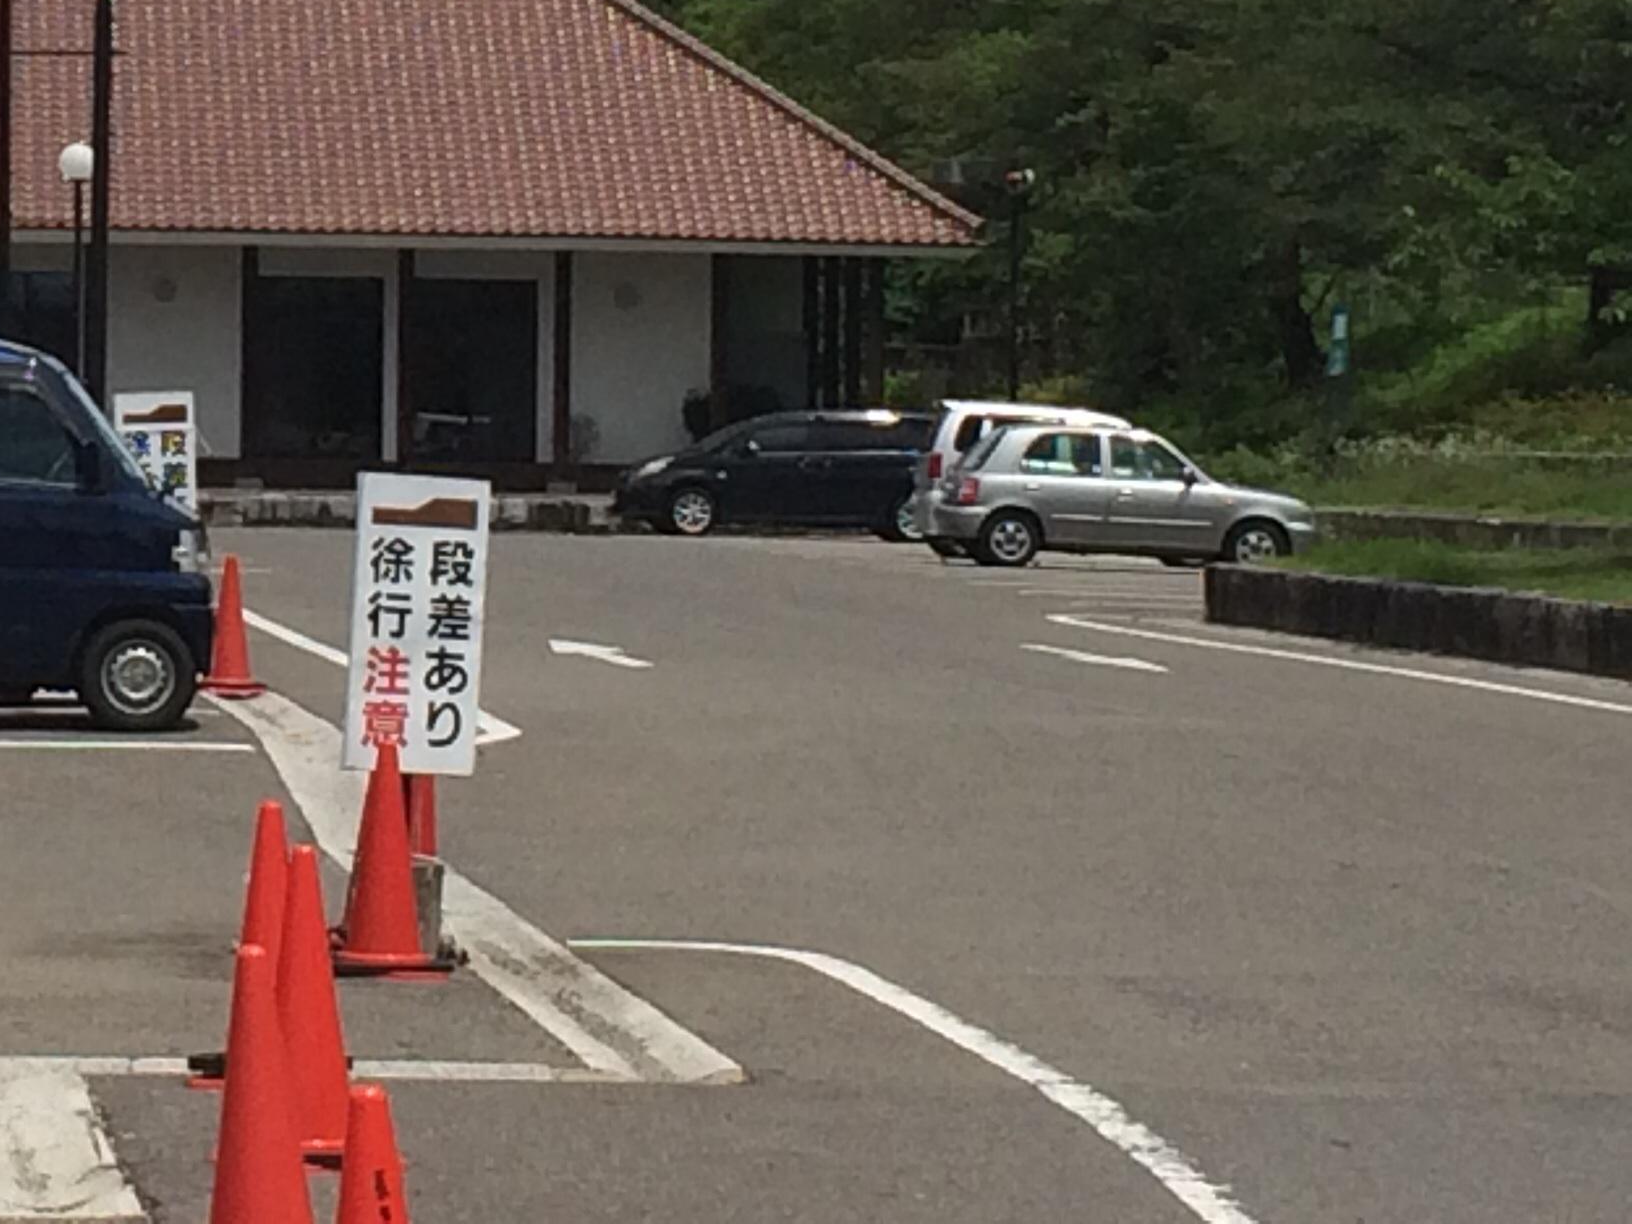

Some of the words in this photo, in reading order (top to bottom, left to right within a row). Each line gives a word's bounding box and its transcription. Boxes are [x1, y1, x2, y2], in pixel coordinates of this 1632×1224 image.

[361, 536, 415, 748] 徐行注意
[423, 540, 474, 748] 段差あり
